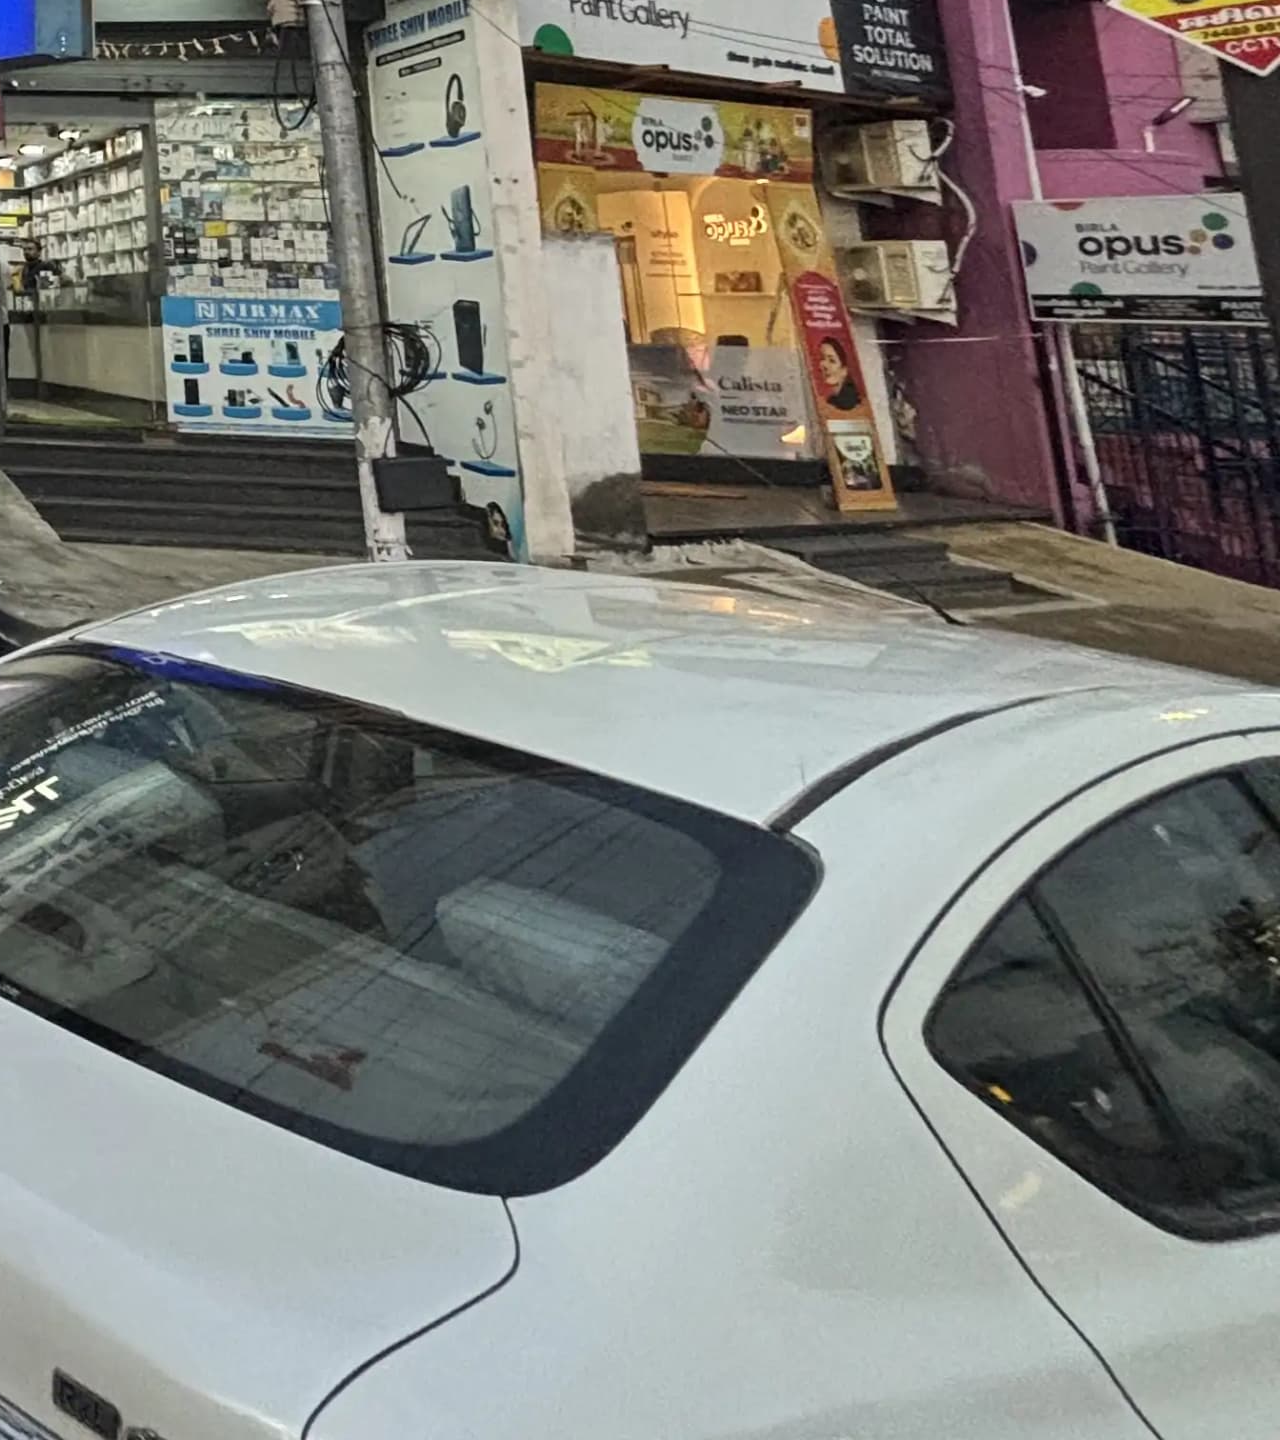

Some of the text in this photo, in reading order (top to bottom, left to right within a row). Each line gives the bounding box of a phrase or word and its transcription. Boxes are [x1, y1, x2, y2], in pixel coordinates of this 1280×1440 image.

[863, 4, 909, 26] PAINT
[400, 13, 425, 37] SHIV
[864, 24, 916, 47] TOTAL
[852, 45, 933, 72] SOLUTION
[642, 130, 692, 152] opus
[1075, 223, 1120, 233] BIRLA
[1078, 234, 1185, 260] opus
[1080, 261, 1189, 278] Paint Gallery
[222, 302, 320, 319] NIRMAX
[206, 327, 316, 340] SHREE SHIV MOBILE
[718, 375, 782, 392] Calista
[752, 406, 787, 417] STAR
